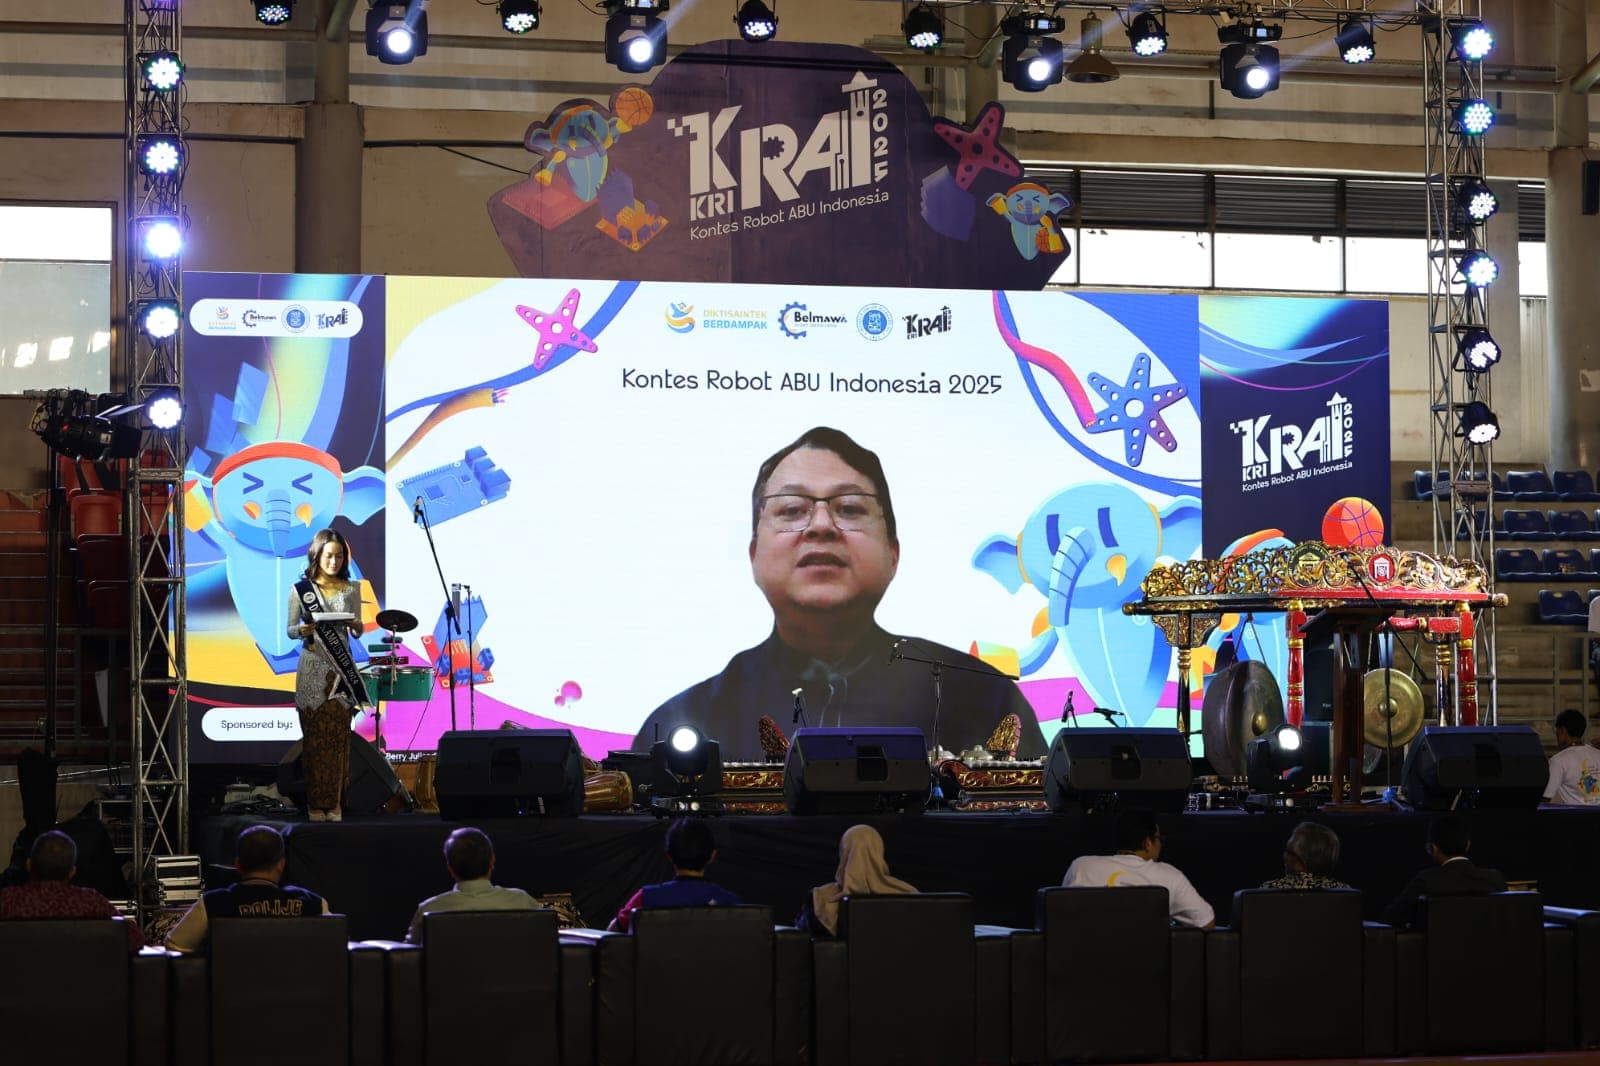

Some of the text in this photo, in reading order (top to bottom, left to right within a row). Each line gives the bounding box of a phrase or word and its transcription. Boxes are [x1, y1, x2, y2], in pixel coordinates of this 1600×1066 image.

[872, 88, 889, 183] 2025
[690, 190, 734, 221] KRI
[690, 188, 889, 240] Kontes Robot ABU Indonesia
[703, 309, 768, 319] DIKTISAINTEK
[703, 319, 768, 330] BERDAMPAK
[622, 368, 1002, 394] Kontes Robot ABU Indonesia 2025
[1242, 463, 1267, 482] KRI
[1242, 460, 1353, 492] Kontes Robot ABU Indonesia
[220, 719, 294, 730] Sponsored by:
